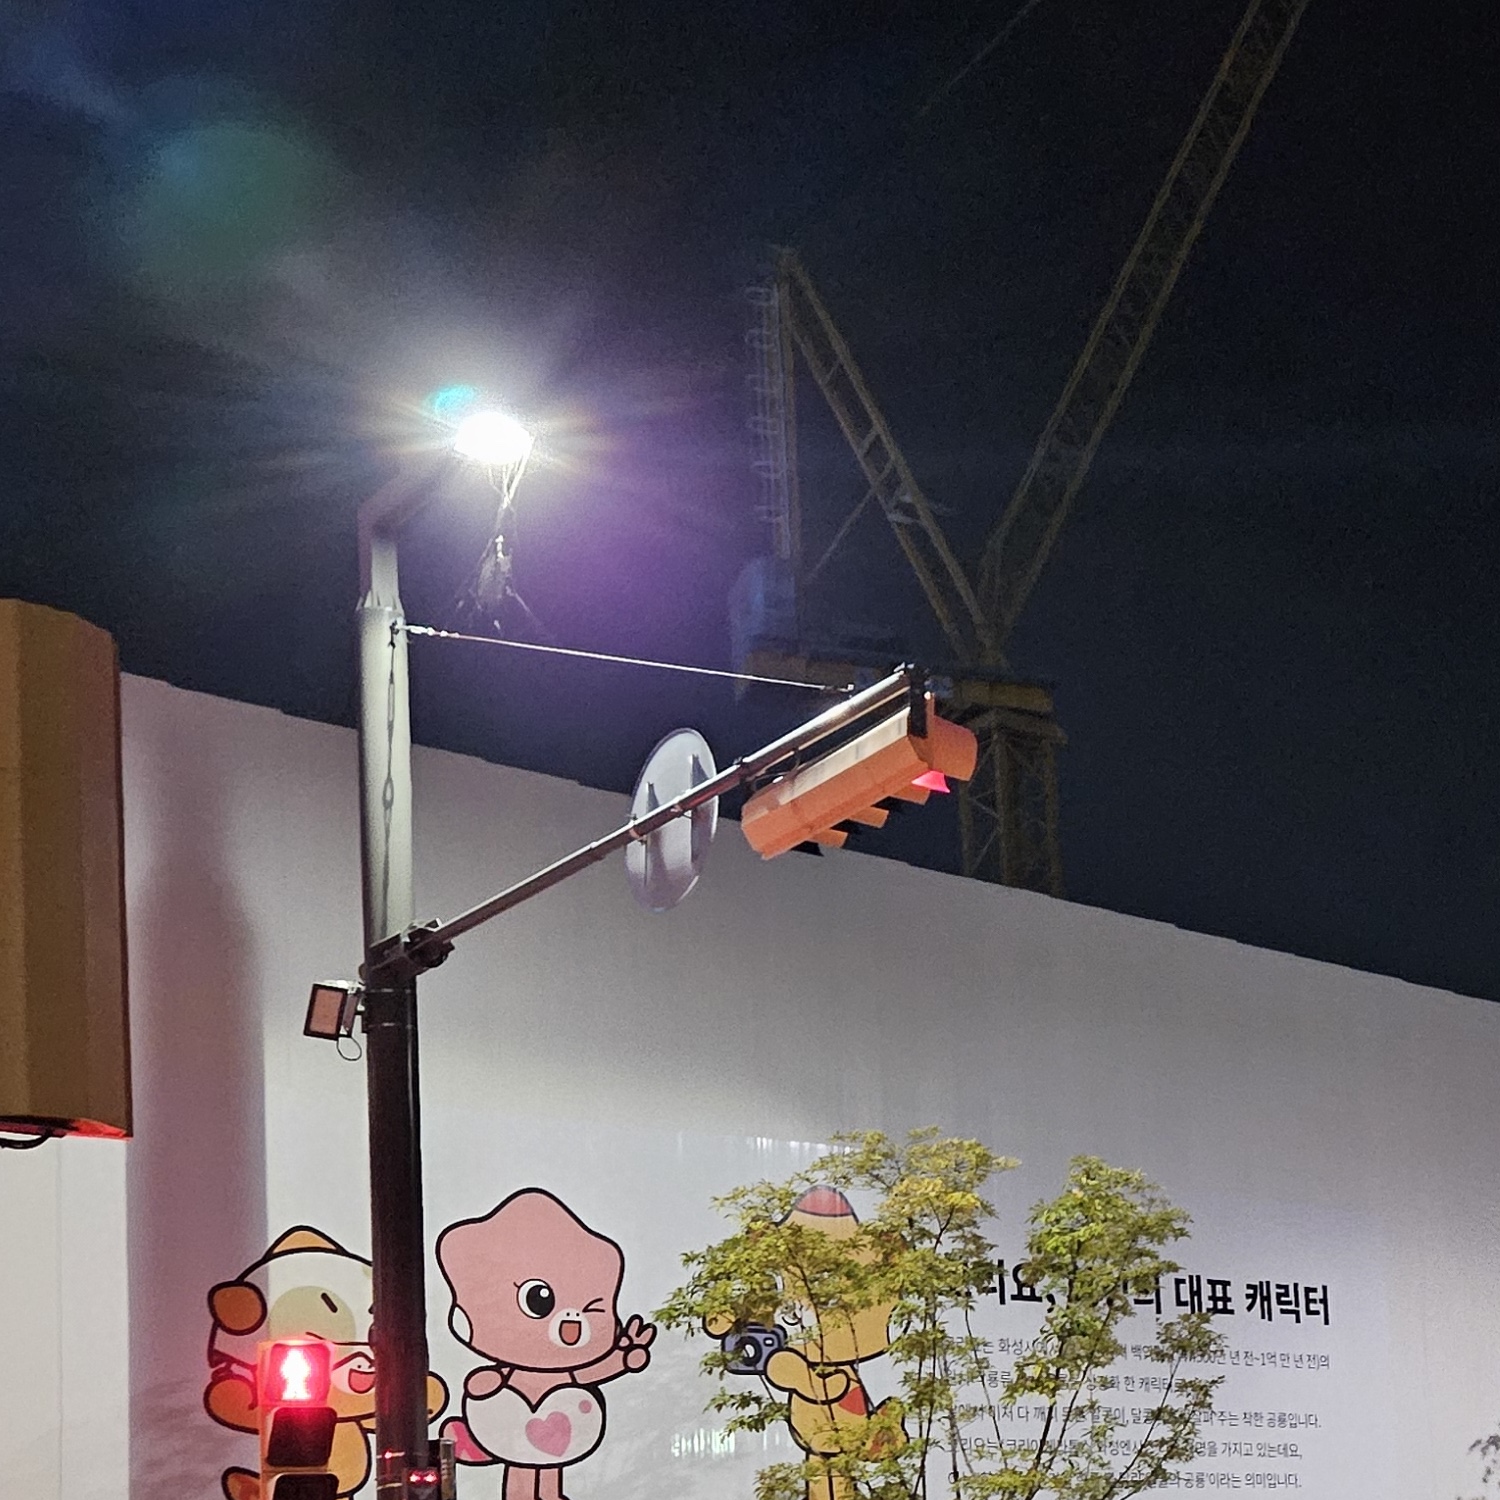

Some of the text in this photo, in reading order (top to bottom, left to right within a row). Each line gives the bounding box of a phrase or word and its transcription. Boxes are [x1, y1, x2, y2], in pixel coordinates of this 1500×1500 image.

[1174, 1274, 1235, 1316] 대표
[1245, 1280, 1330, 1326] 캐릭터
[1306, 1354, 1330, 1371] 전)의
[1123, 1375, 1135, 1392] 한
[1017, 1405, 1030, 1422] 다
[1218, 1410, 1239, 1427] 주는
[1242, 1411, 1264, 1428] 착한
[1266, 1412, 1322, 1429] 공룡입니다.
[1221, 1441, 1254, 1458] 가지고
[1256, 1442, 1303, 1460] 있는데요,
[1244, 1472, 1303, 1490] 의미입니다.
